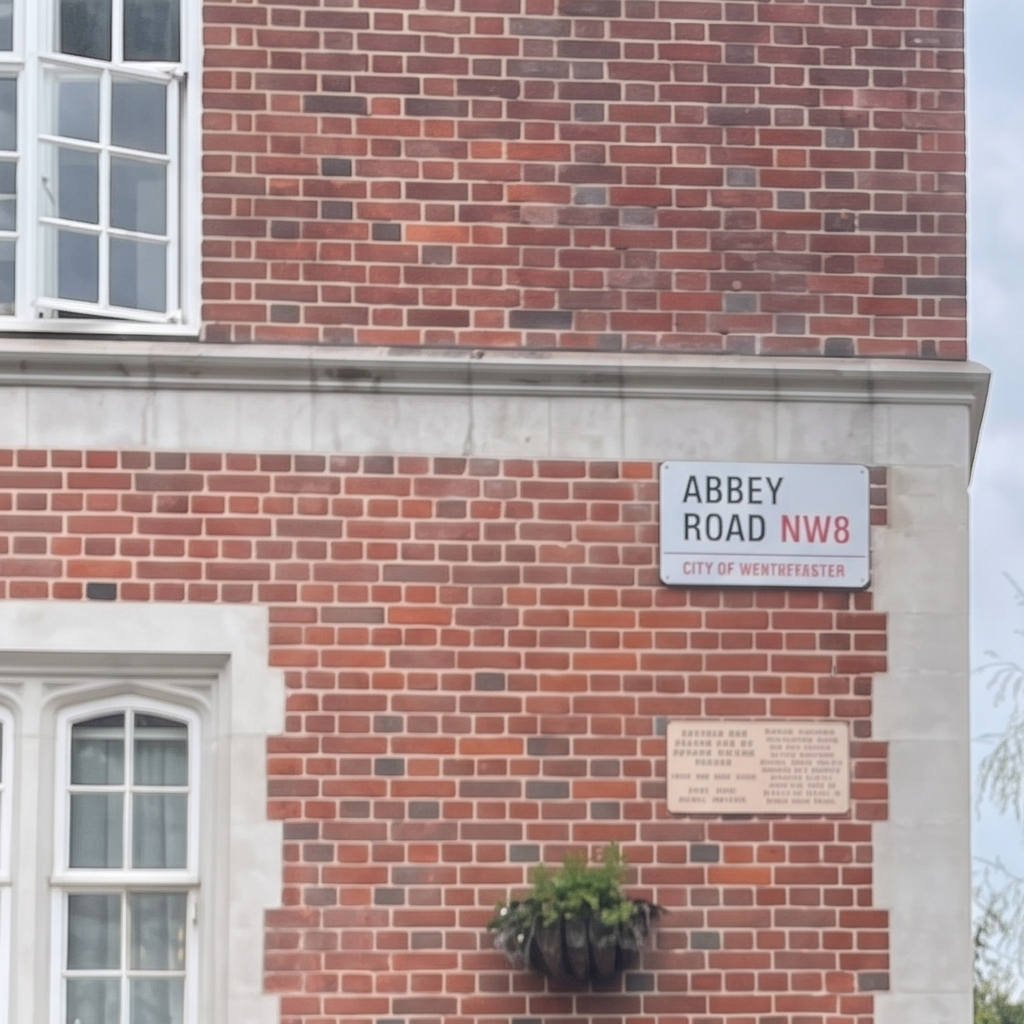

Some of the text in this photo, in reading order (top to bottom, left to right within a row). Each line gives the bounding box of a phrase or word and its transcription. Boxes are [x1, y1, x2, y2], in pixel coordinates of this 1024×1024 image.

[682, 475, 784, 505] ABBEY
[683, 513, 850, 544] ROAD NW8
[682, 561, 713, 576] CITY
[717, 562, 735, 576] OF
